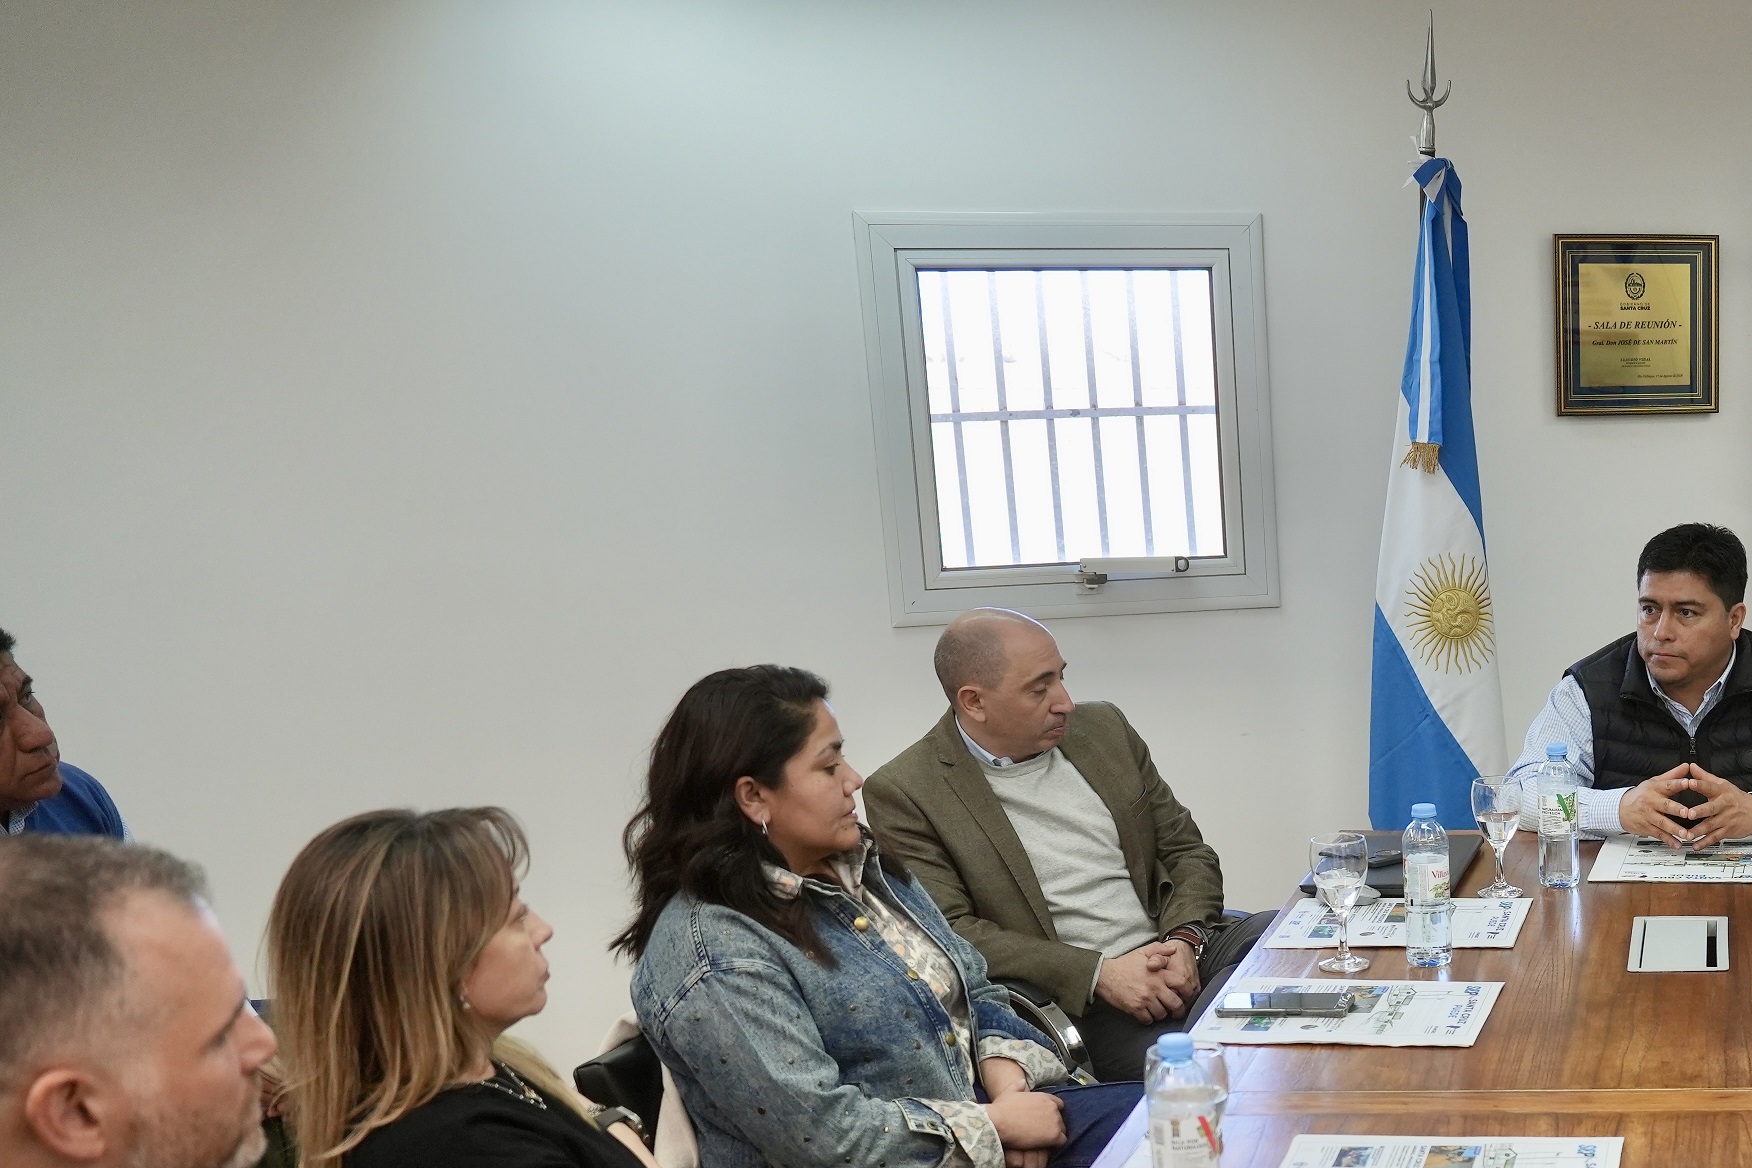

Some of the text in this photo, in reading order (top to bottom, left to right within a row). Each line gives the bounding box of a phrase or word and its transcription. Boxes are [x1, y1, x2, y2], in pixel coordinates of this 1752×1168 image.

[1593, 320, 1617, 330] SALA
[1619, 320, 1632, 330] DE
[1634, 319, 1677, 330] REUNIÓN
[1618, 338, 1632, 346] JOSÉ
[1655, 338, 1678, 346] MARTÍN
[1463, 999, 1478, 1012] SANTA
